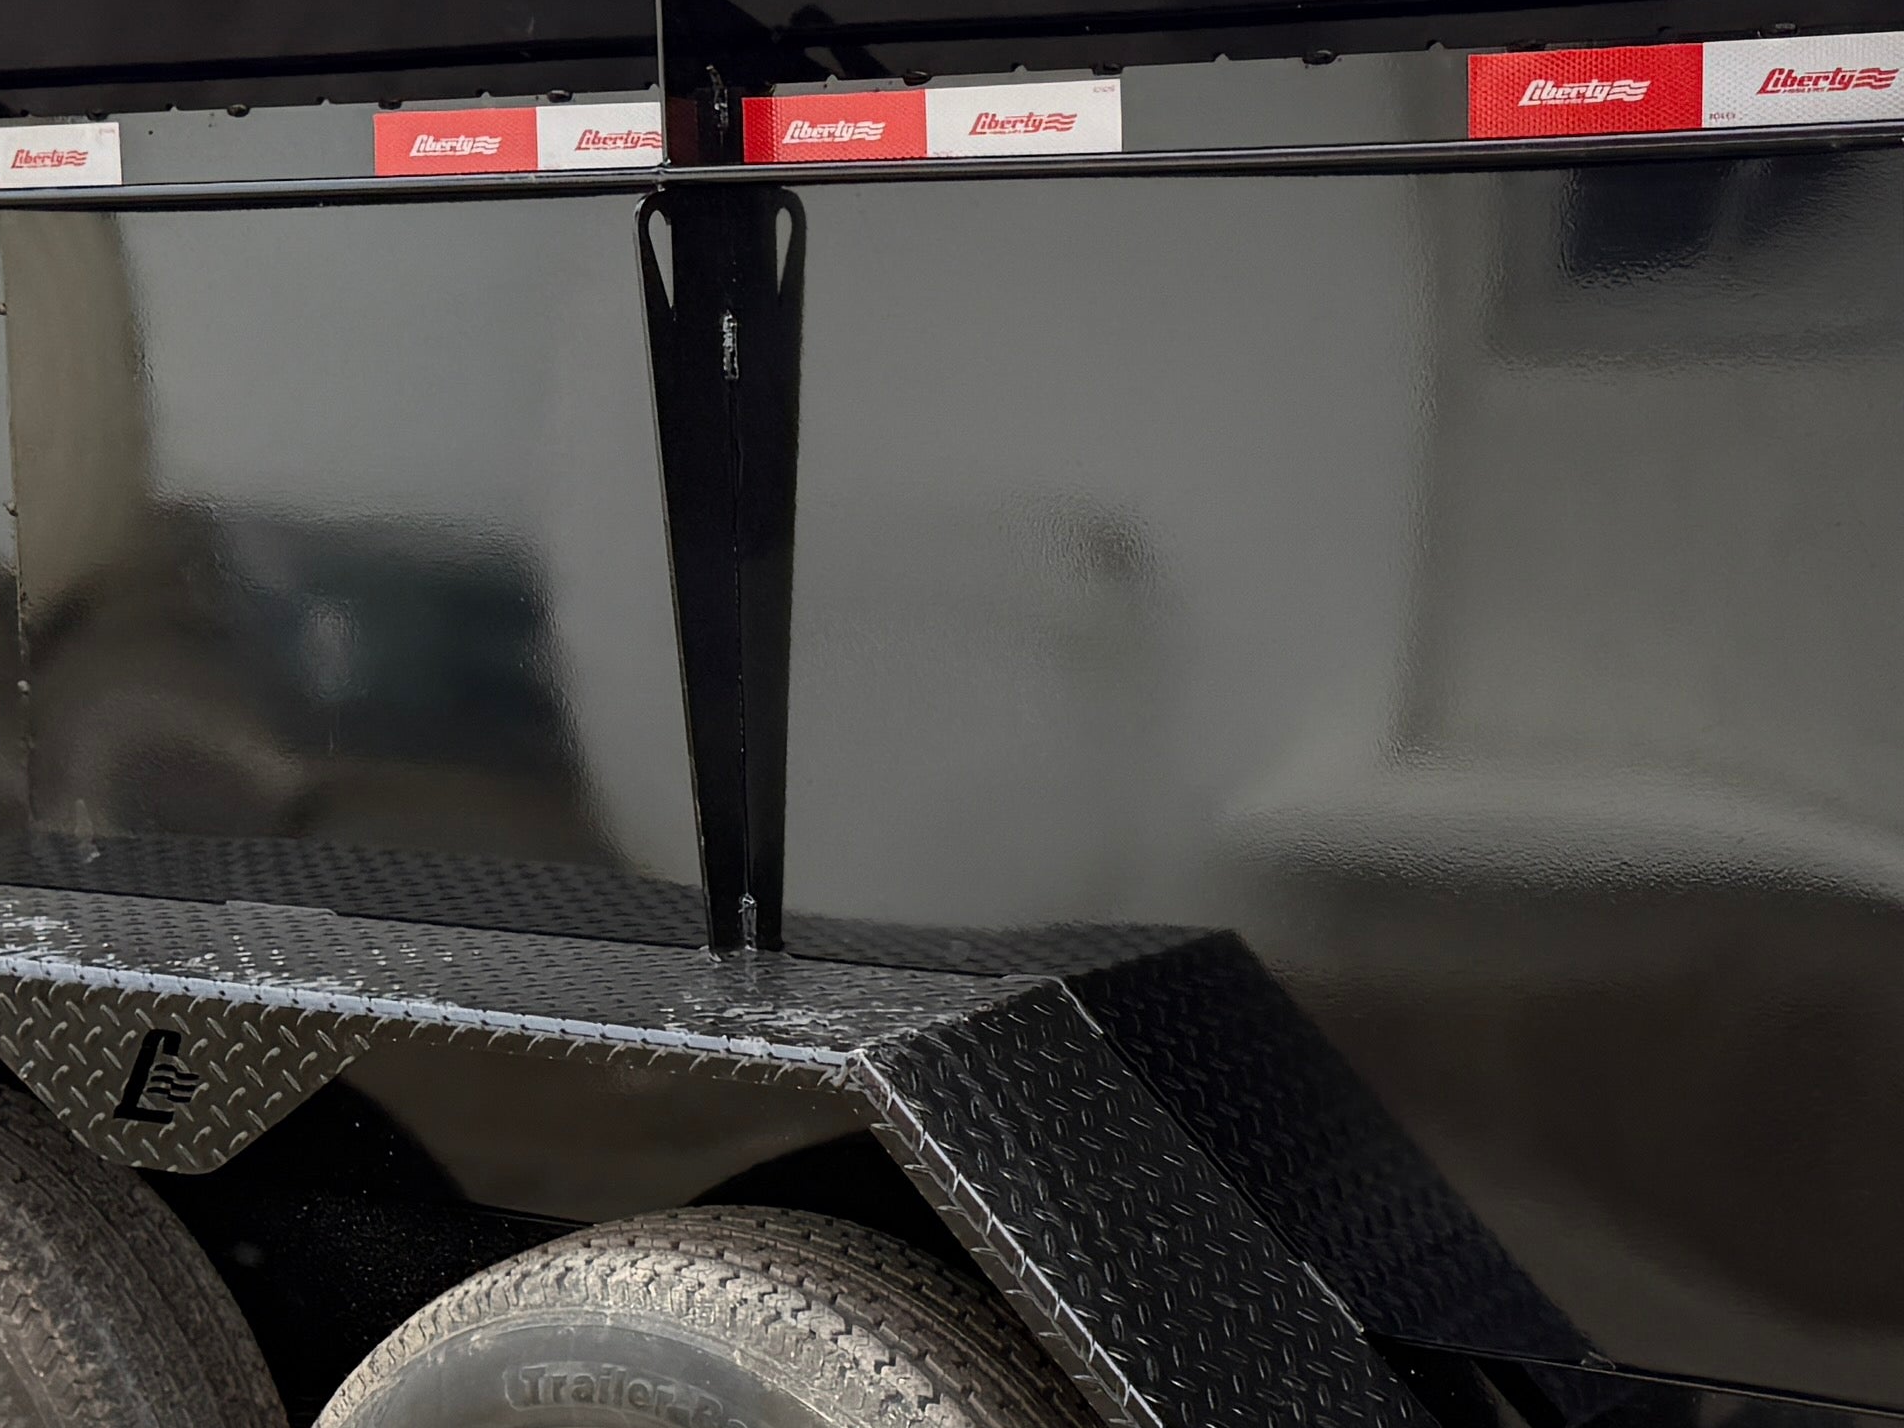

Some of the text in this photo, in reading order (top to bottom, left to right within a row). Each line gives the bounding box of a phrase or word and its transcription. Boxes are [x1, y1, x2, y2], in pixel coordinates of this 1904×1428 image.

[1518, 78, 1611, 107] Liberty
[1756, 68, 1856, 95] Liberty
[782, 120, 854, 144] Liberty
[969, 112, 1044, 136] Liberty
[410, 134, 474, 157] Liberty
[575, 129, 641, 151] Liberty
[519, 1362, 676, 1417] Trailer
